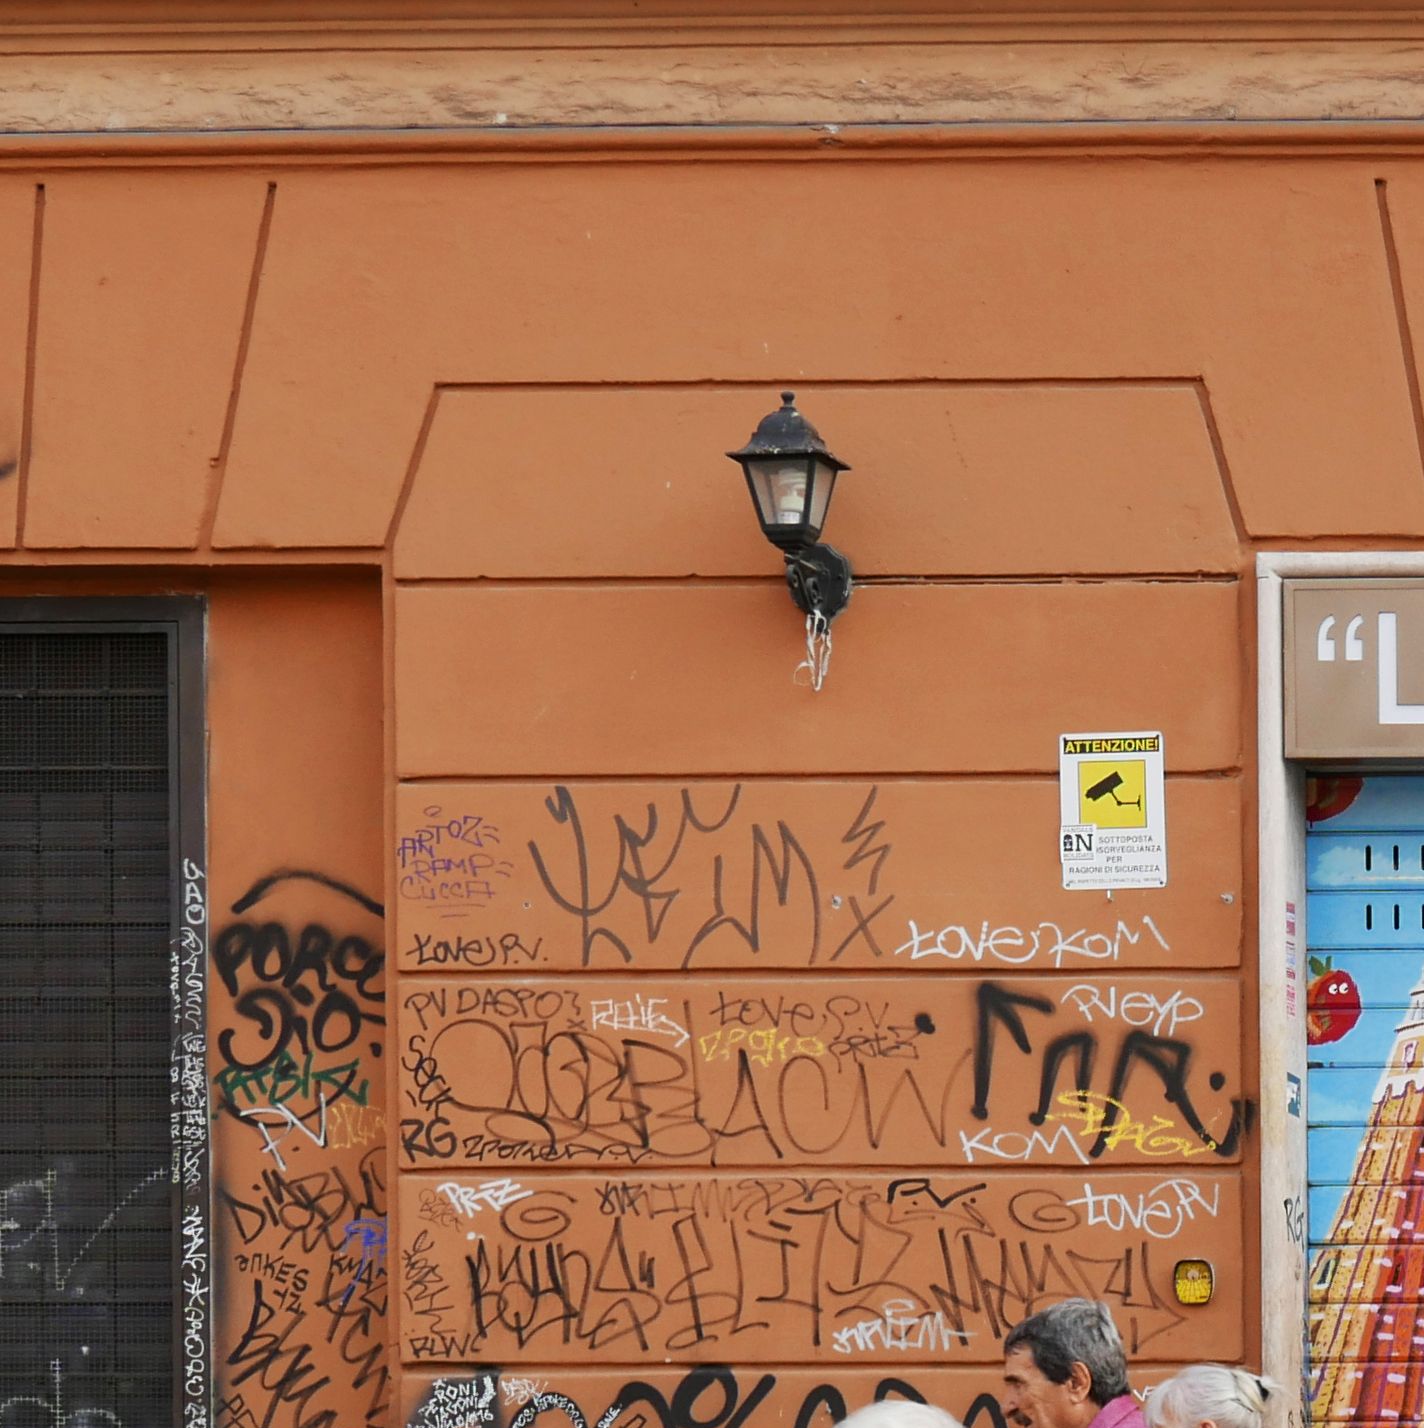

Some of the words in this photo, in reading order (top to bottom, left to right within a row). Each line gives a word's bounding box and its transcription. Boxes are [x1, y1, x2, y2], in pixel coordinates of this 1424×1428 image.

[1065, 739, 1159, 753] ATTENZIONE!
[1098, 835, 1154, 844] SOTTOPOSTA
[1106, 855, 1123, 864] PER
[1069, 866, 1103, 875] RAGIONI
[1114, 864, 1161, 874] SICUREZZA
